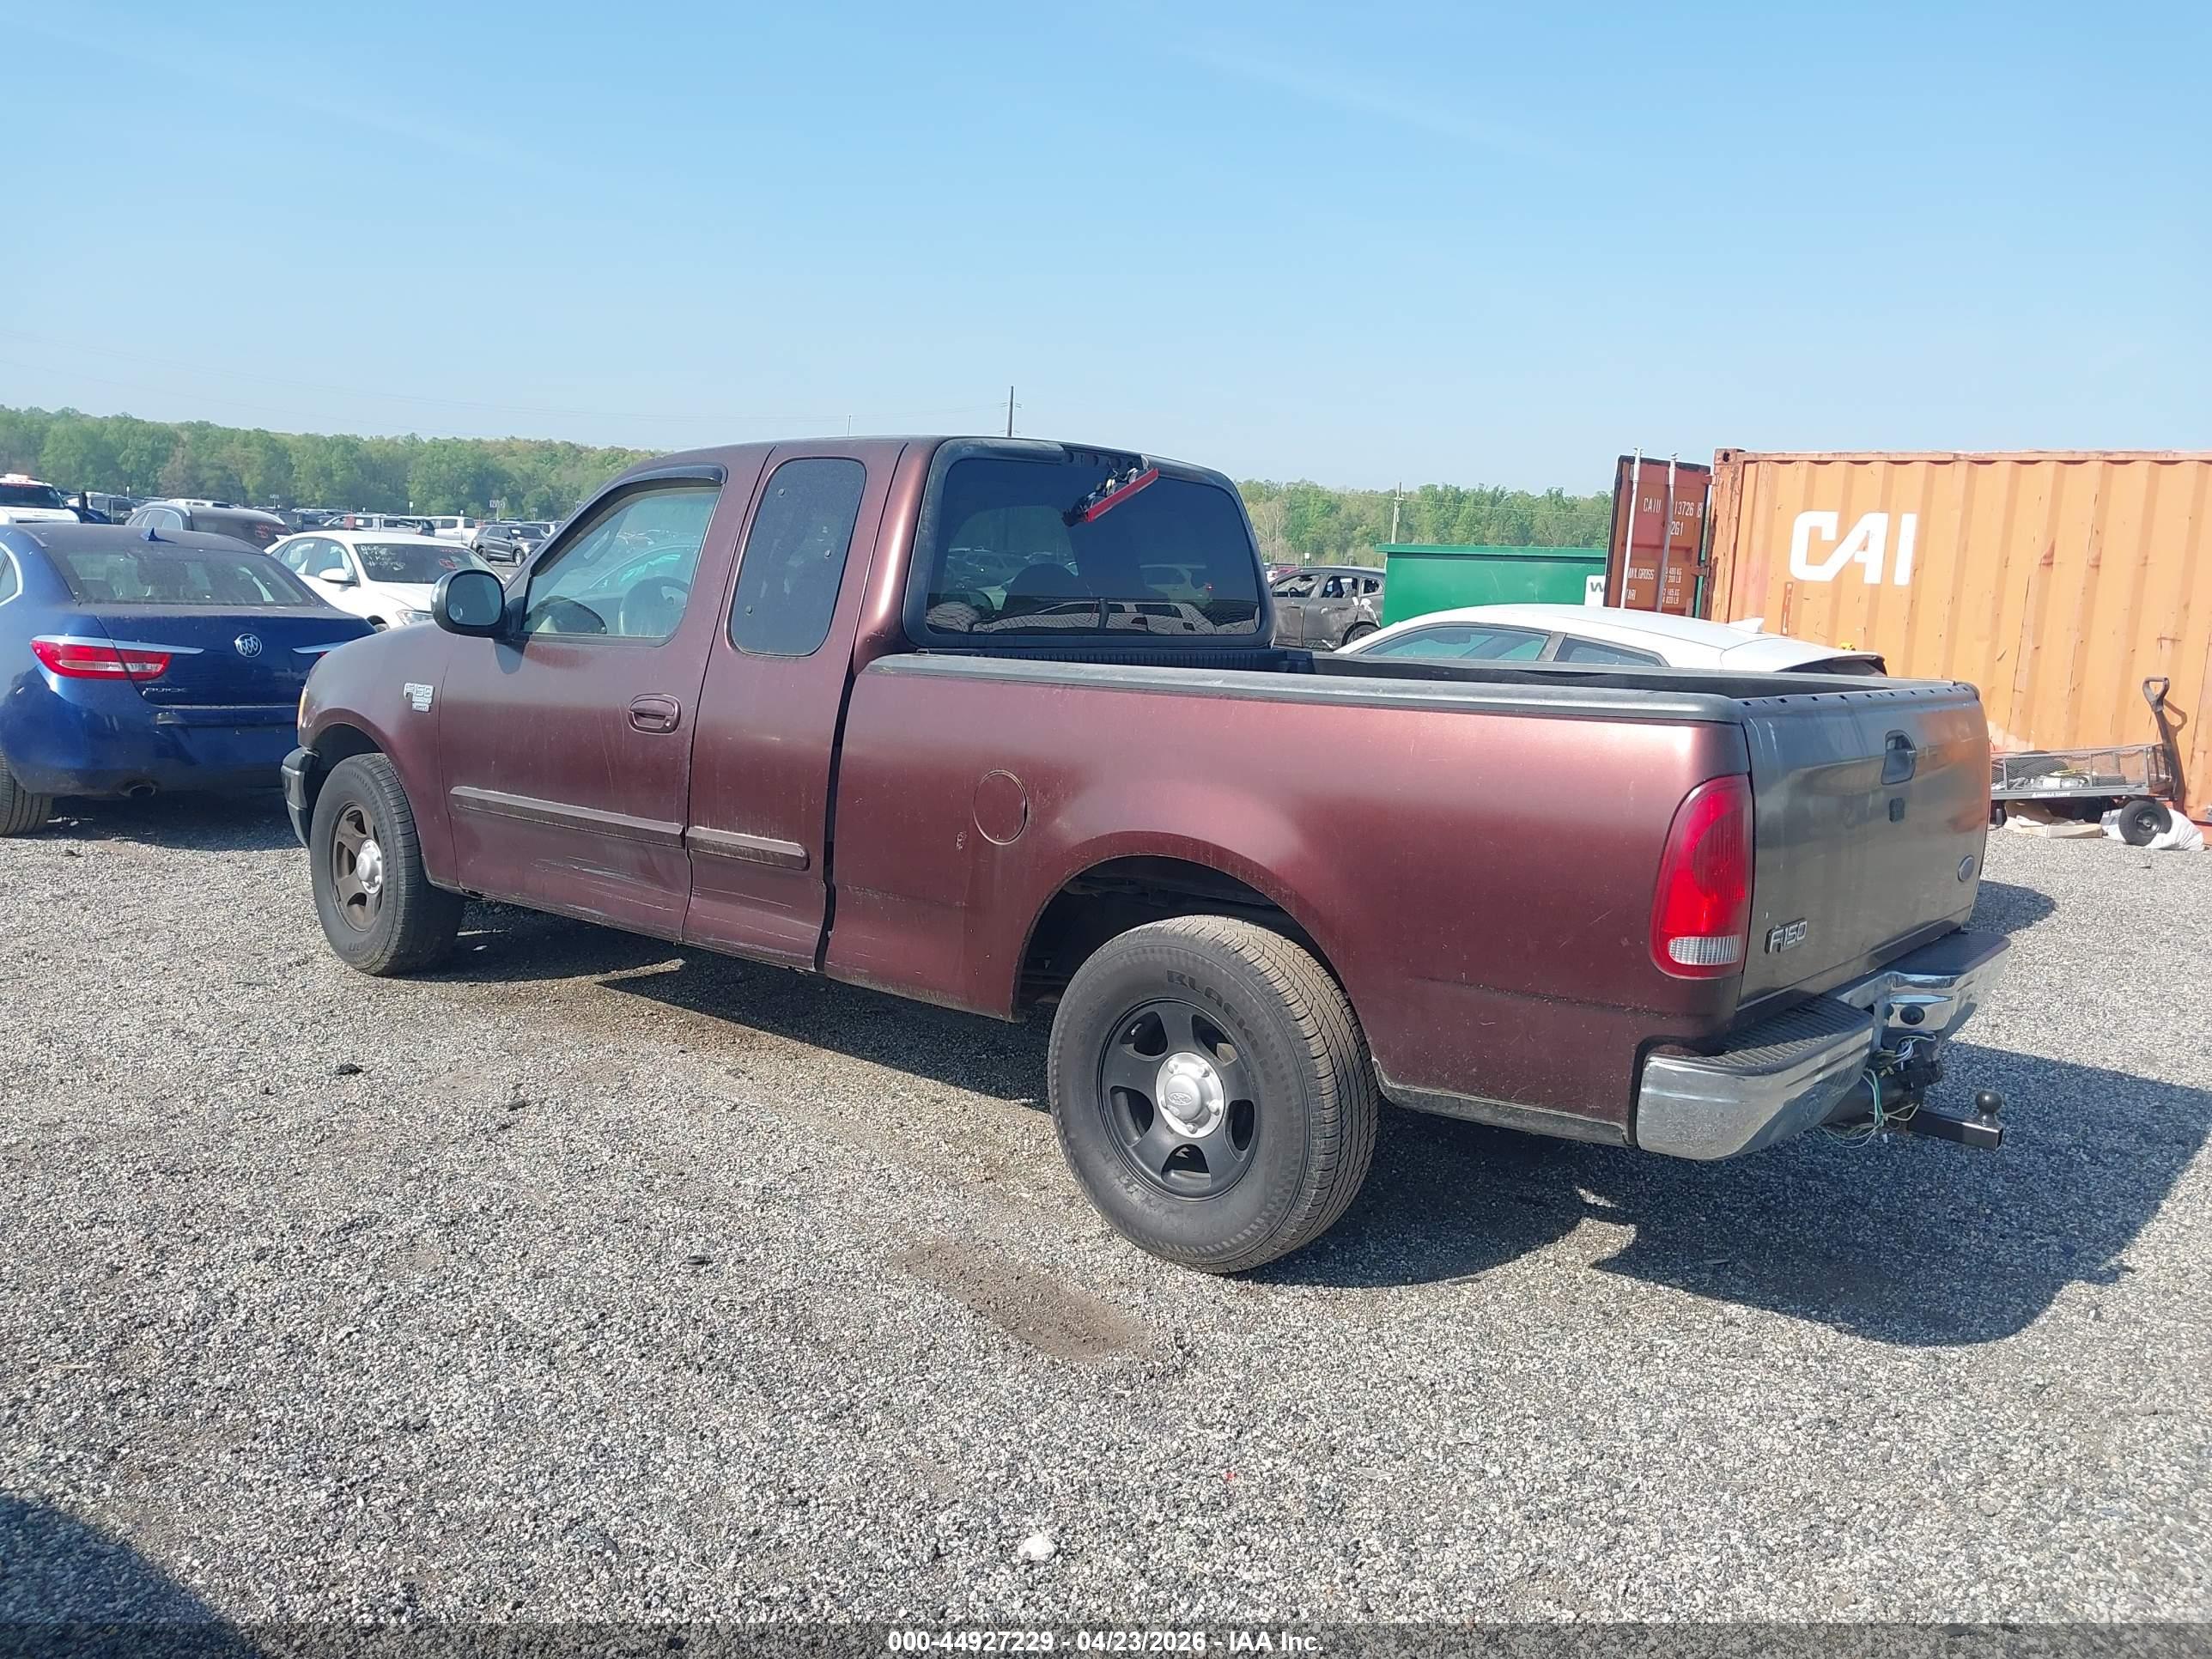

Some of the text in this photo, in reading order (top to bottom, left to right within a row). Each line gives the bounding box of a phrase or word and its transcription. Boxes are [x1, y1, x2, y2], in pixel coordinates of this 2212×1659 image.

[1643, 498, 1662, 514] CAIU
[1674, 501, 1695, 516] 13726
[1789, 510, 1917, 586] CAI
